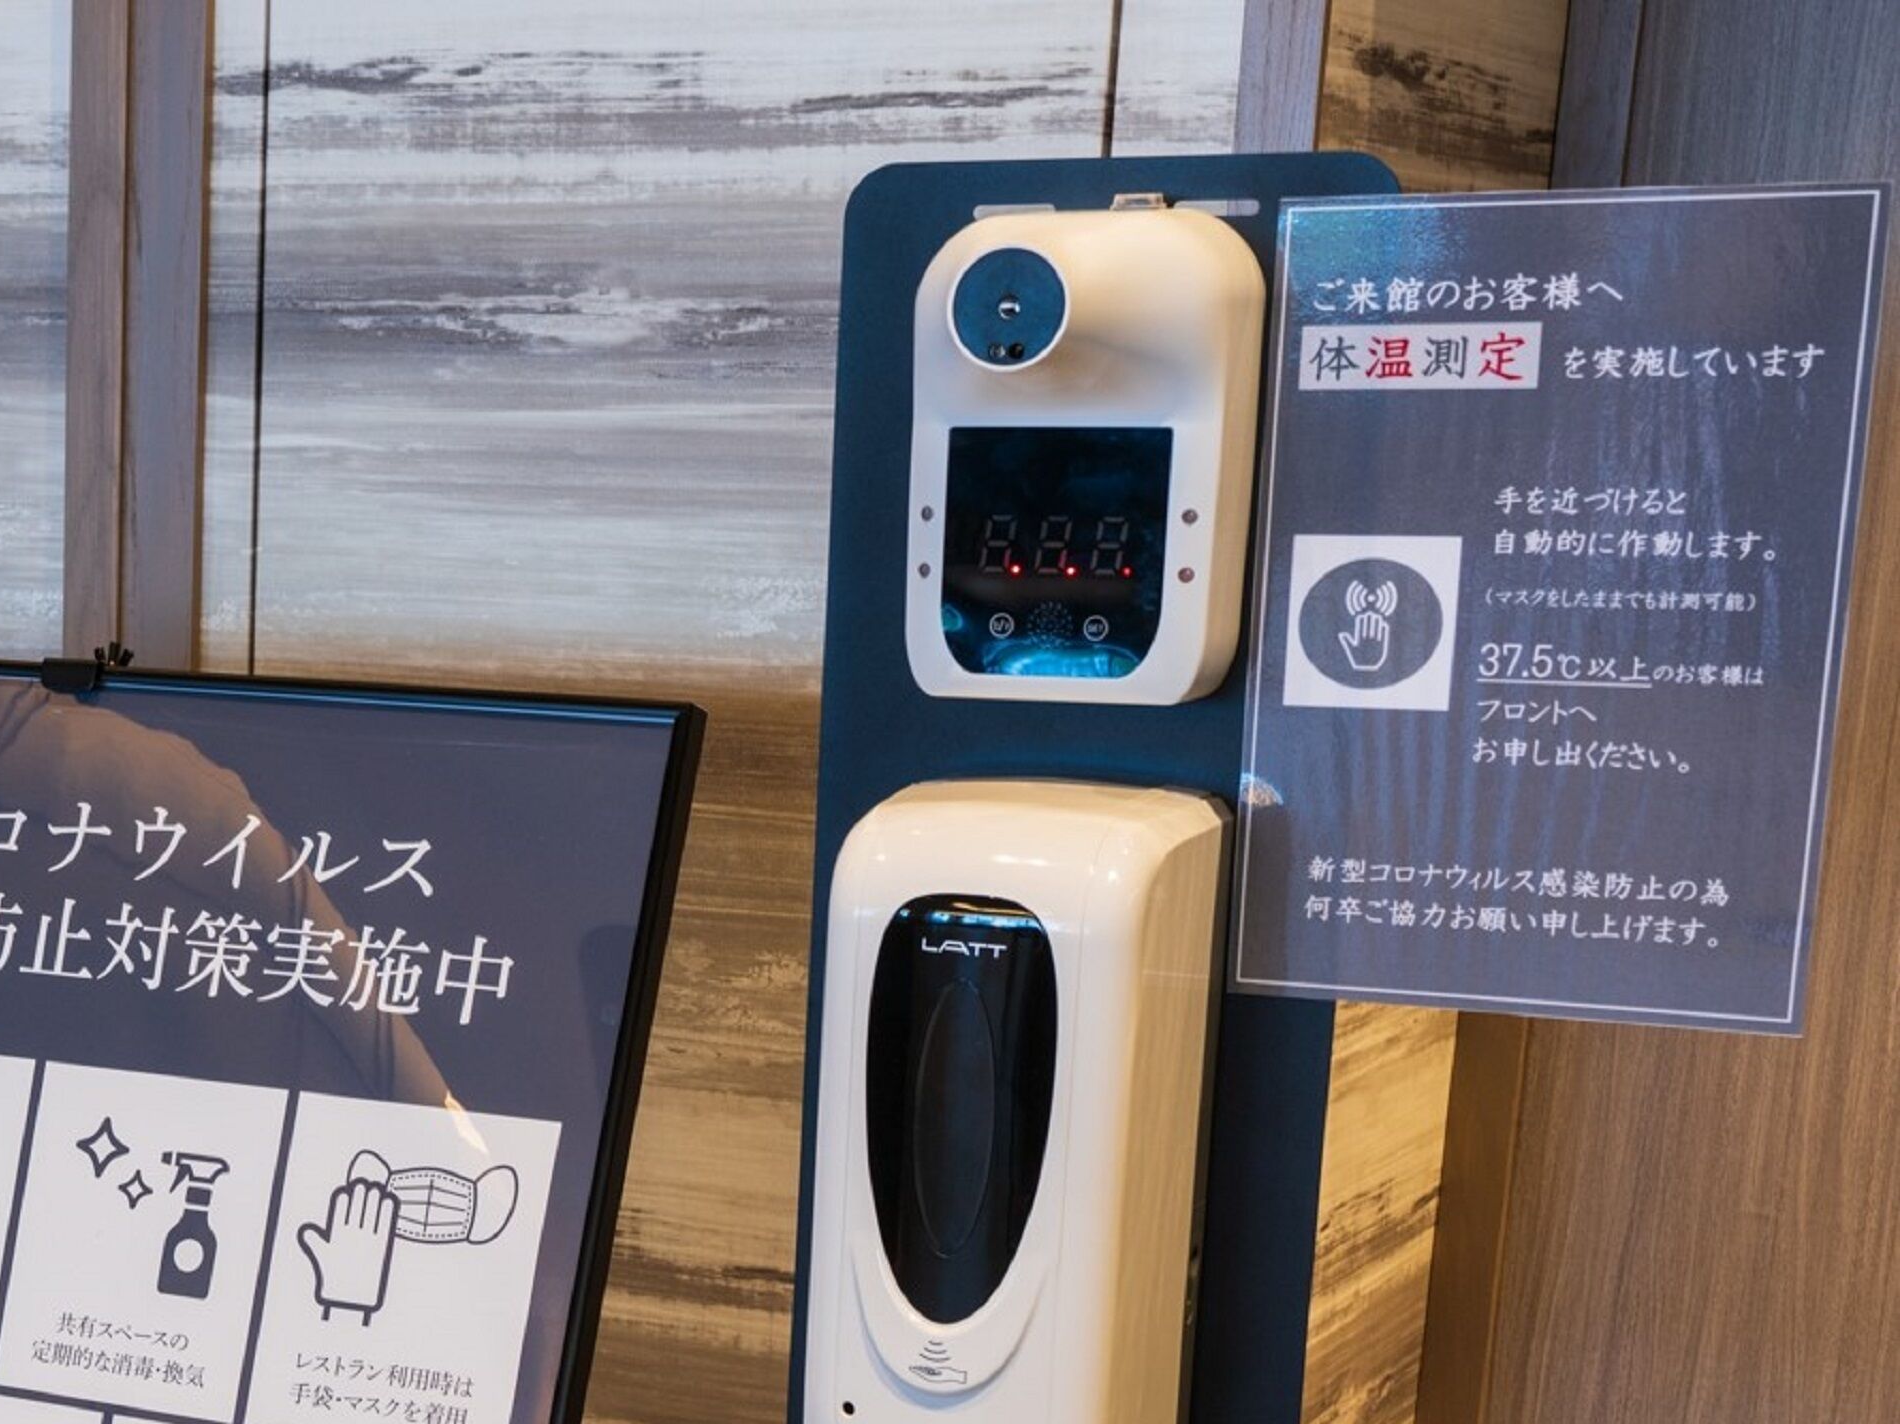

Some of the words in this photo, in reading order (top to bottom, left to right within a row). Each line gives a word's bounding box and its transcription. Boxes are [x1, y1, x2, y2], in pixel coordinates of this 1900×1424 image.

[1310, 272, 1625, 314] ご来館のお客様へ
[1308, 332, 1528, 383] 体温測定
[1563, 344, 1827, 380] を実施しています
[1493, 488, 1688, 516] 手を近づけると
[1493, 530, 1778, 562] 自動的に作動します。
[1477, 699, 1598, 724] フロントへ
[1471, 737, 1691, 774] お申し出ください。
[1306, 855, 1730, 907] 新型コロナウィルス感染防止の為
[1303, 894, 1719, 949] 何卒ご協力お願い申し上げます。
[921, 937, 1008, 959] LATT
[55, 1311, 190, 1351] 共有スペースの
[294, 1351, 476, 1399] レストラン利用時は
